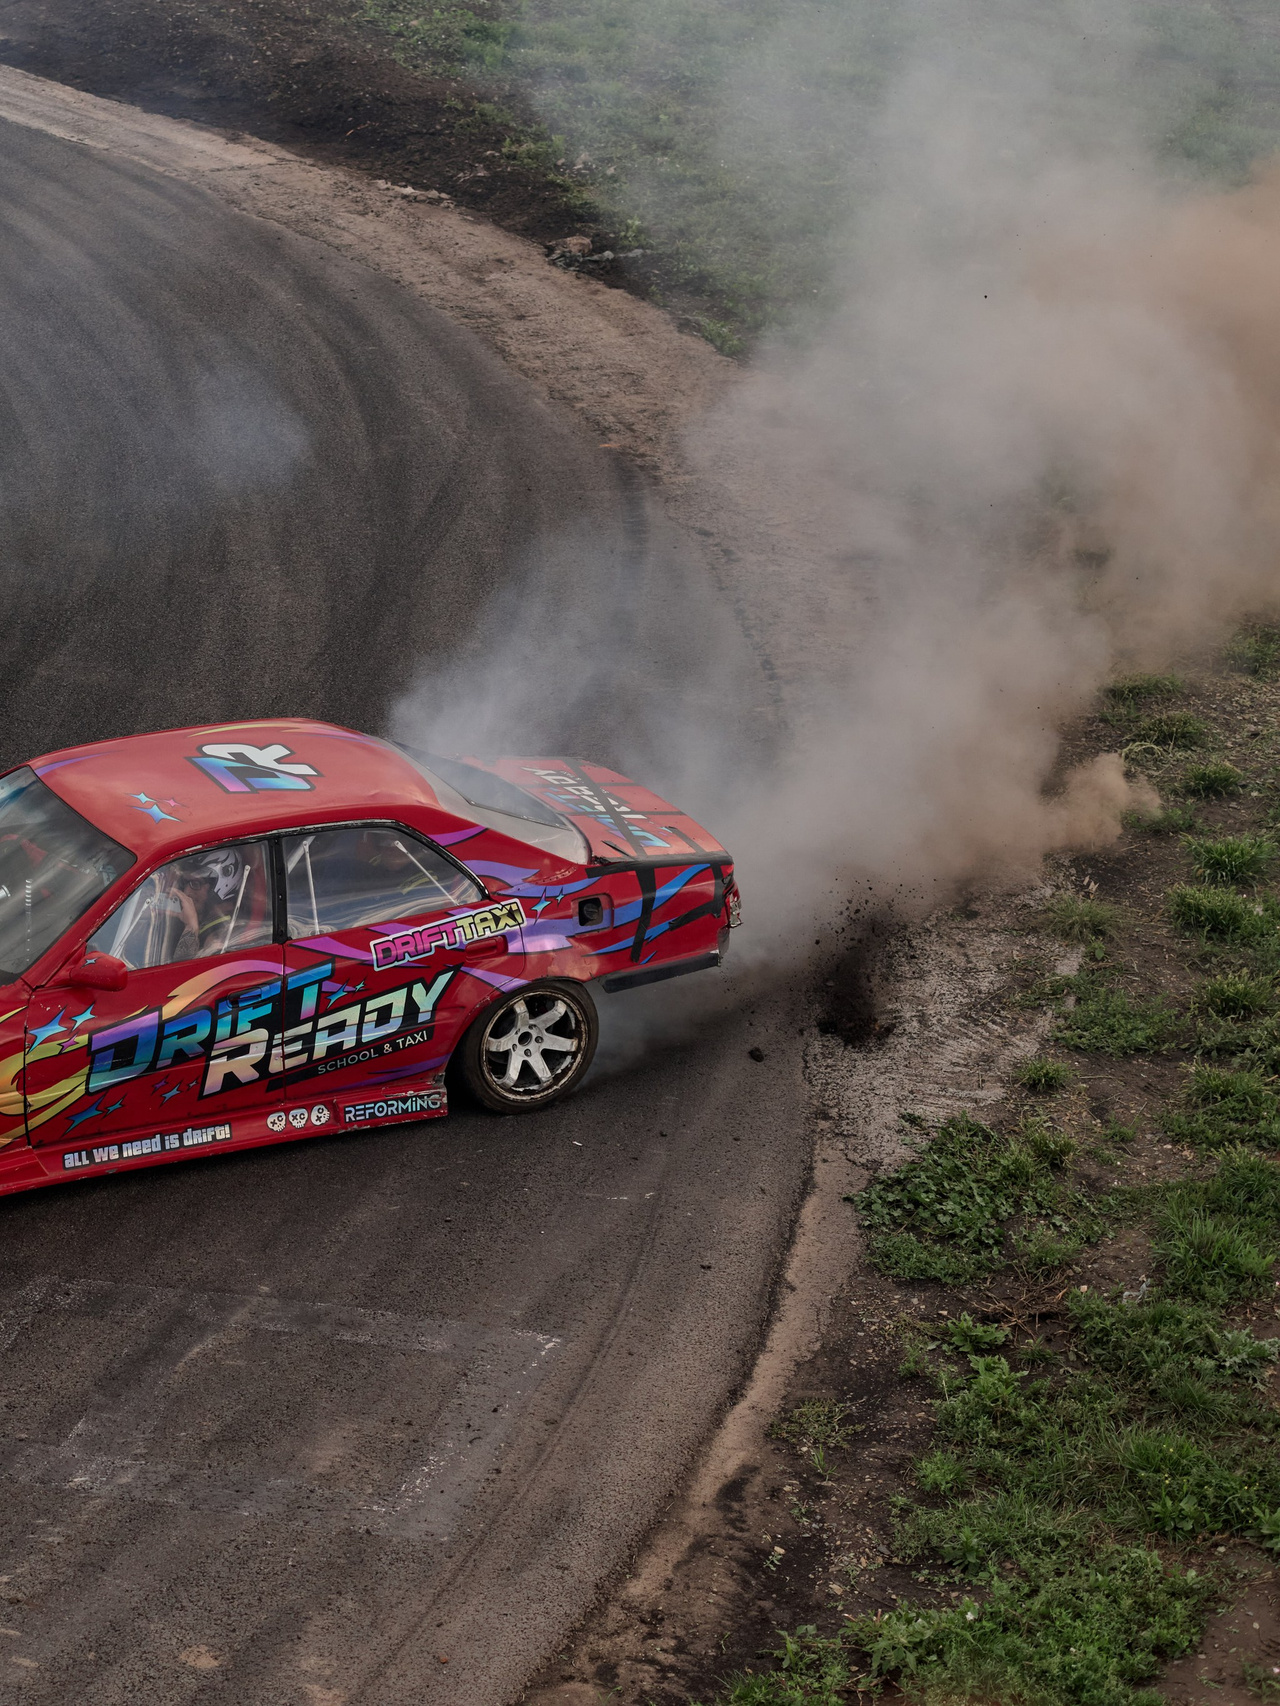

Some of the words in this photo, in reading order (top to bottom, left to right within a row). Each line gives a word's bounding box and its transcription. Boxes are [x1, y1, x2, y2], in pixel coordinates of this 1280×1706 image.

[203, 969, 456, 1096] READY
[317, 1050, 379, 1075] SCHOOL
[383, 1042, 393, 1054] &
[396, 1030, 428, 1050] TAXI
[122, 1134, 162, 1158] need
[165, 1133, 180, 1150] is
